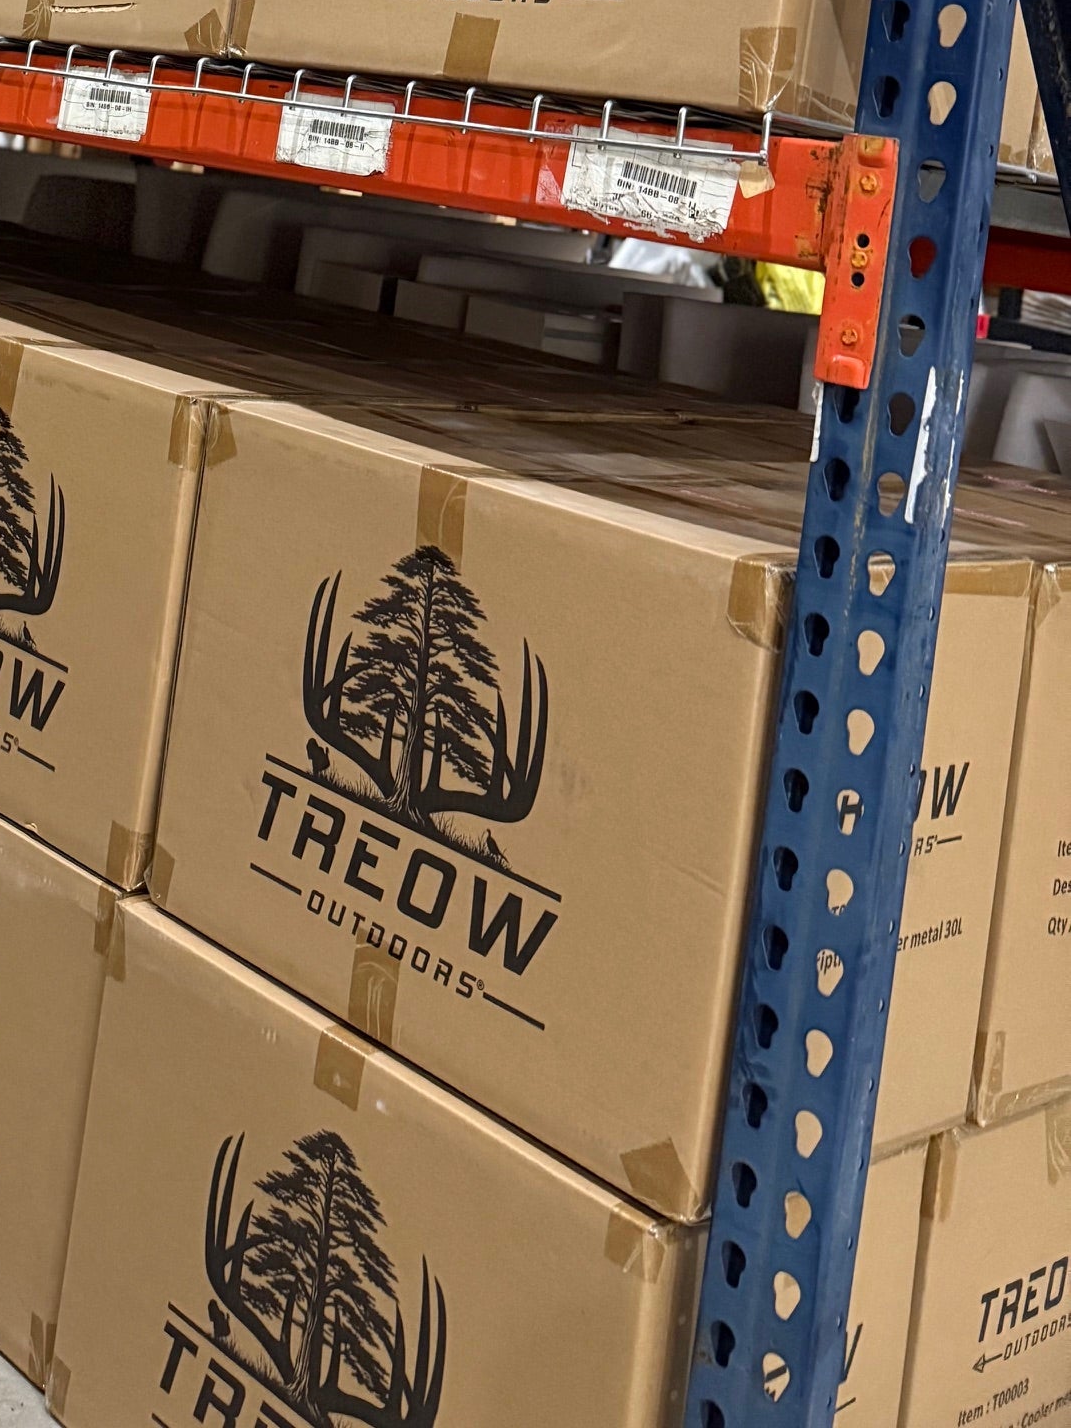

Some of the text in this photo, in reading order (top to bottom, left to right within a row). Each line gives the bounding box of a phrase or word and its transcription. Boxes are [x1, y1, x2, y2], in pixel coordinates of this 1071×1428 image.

[257, 770, 559, 976] TREOW
[306, 889, 478, 999] OUTDOORS
[911, 919, 943, 949] metal
[958, 1405, 984, 1427] Item
